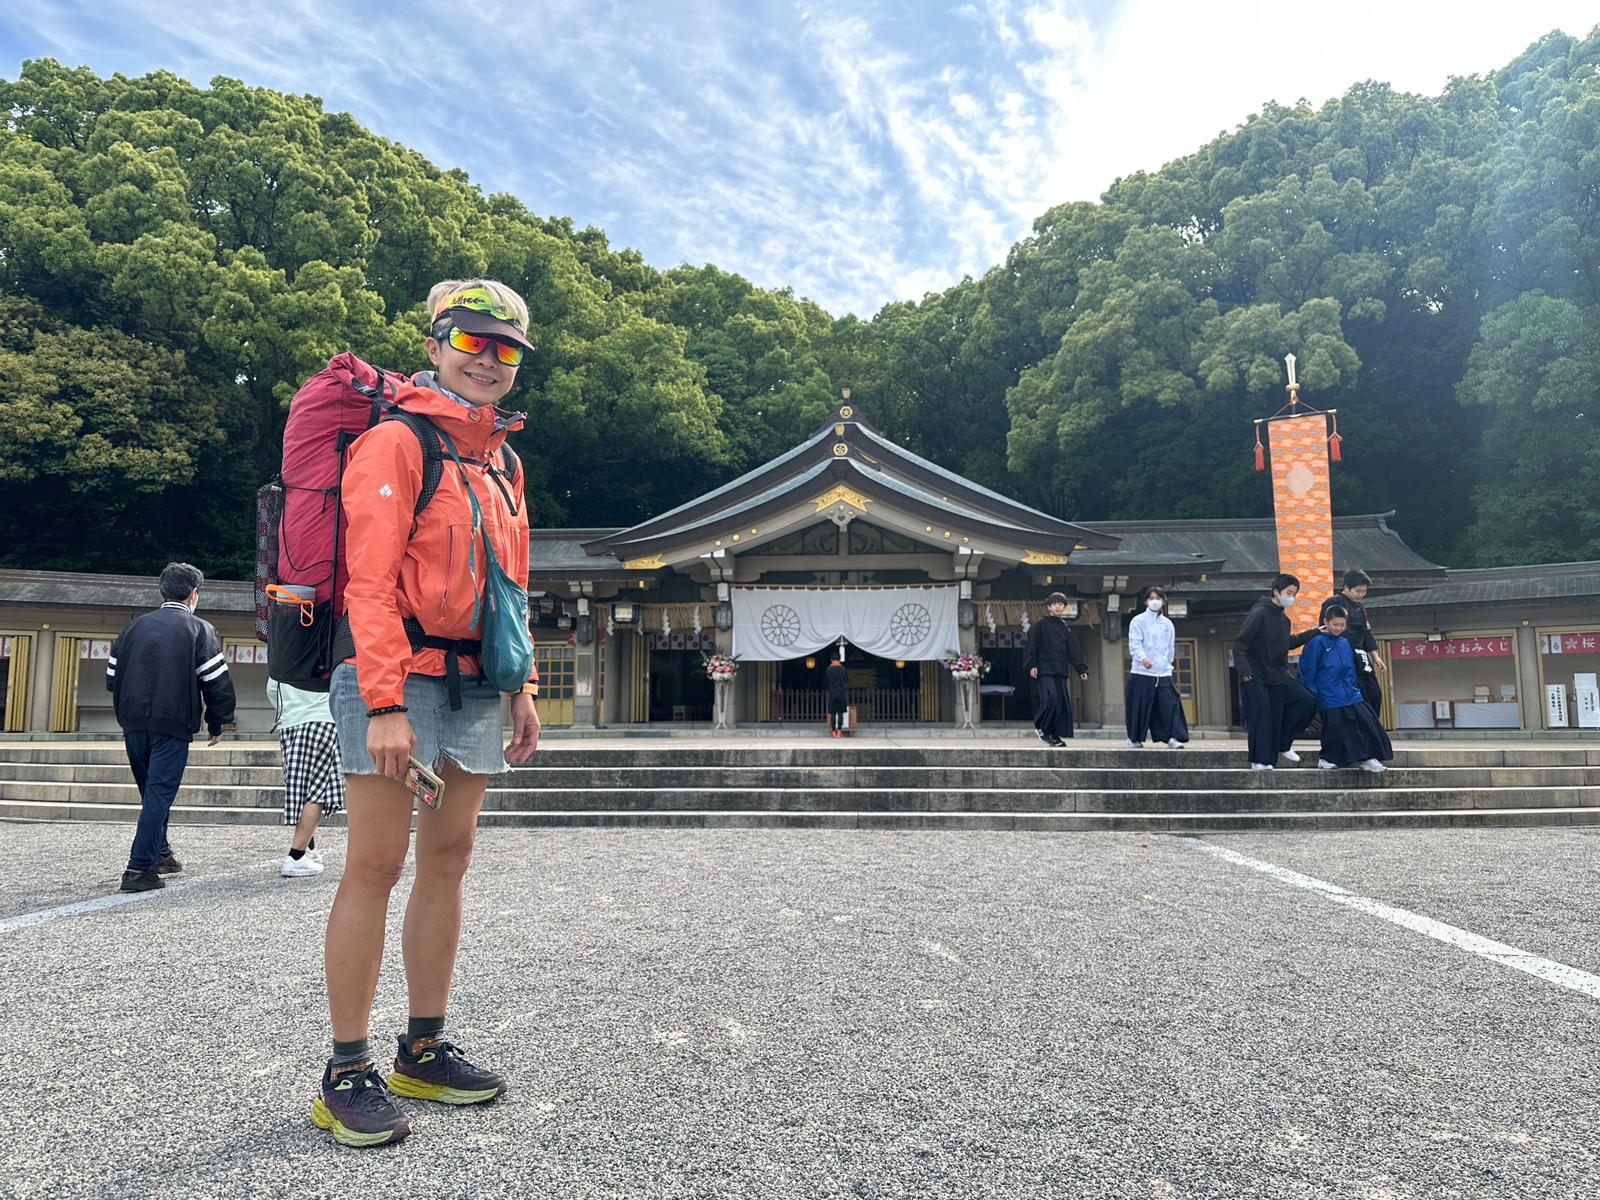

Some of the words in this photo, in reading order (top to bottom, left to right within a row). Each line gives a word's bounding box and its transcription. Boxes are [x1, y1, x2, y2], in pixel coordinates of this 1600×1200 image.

[1400, 642, 1440, 656] お守り
[1459, 641, 1509, 653] おみくじ
[1582, 637, 1596, 649] 桜
